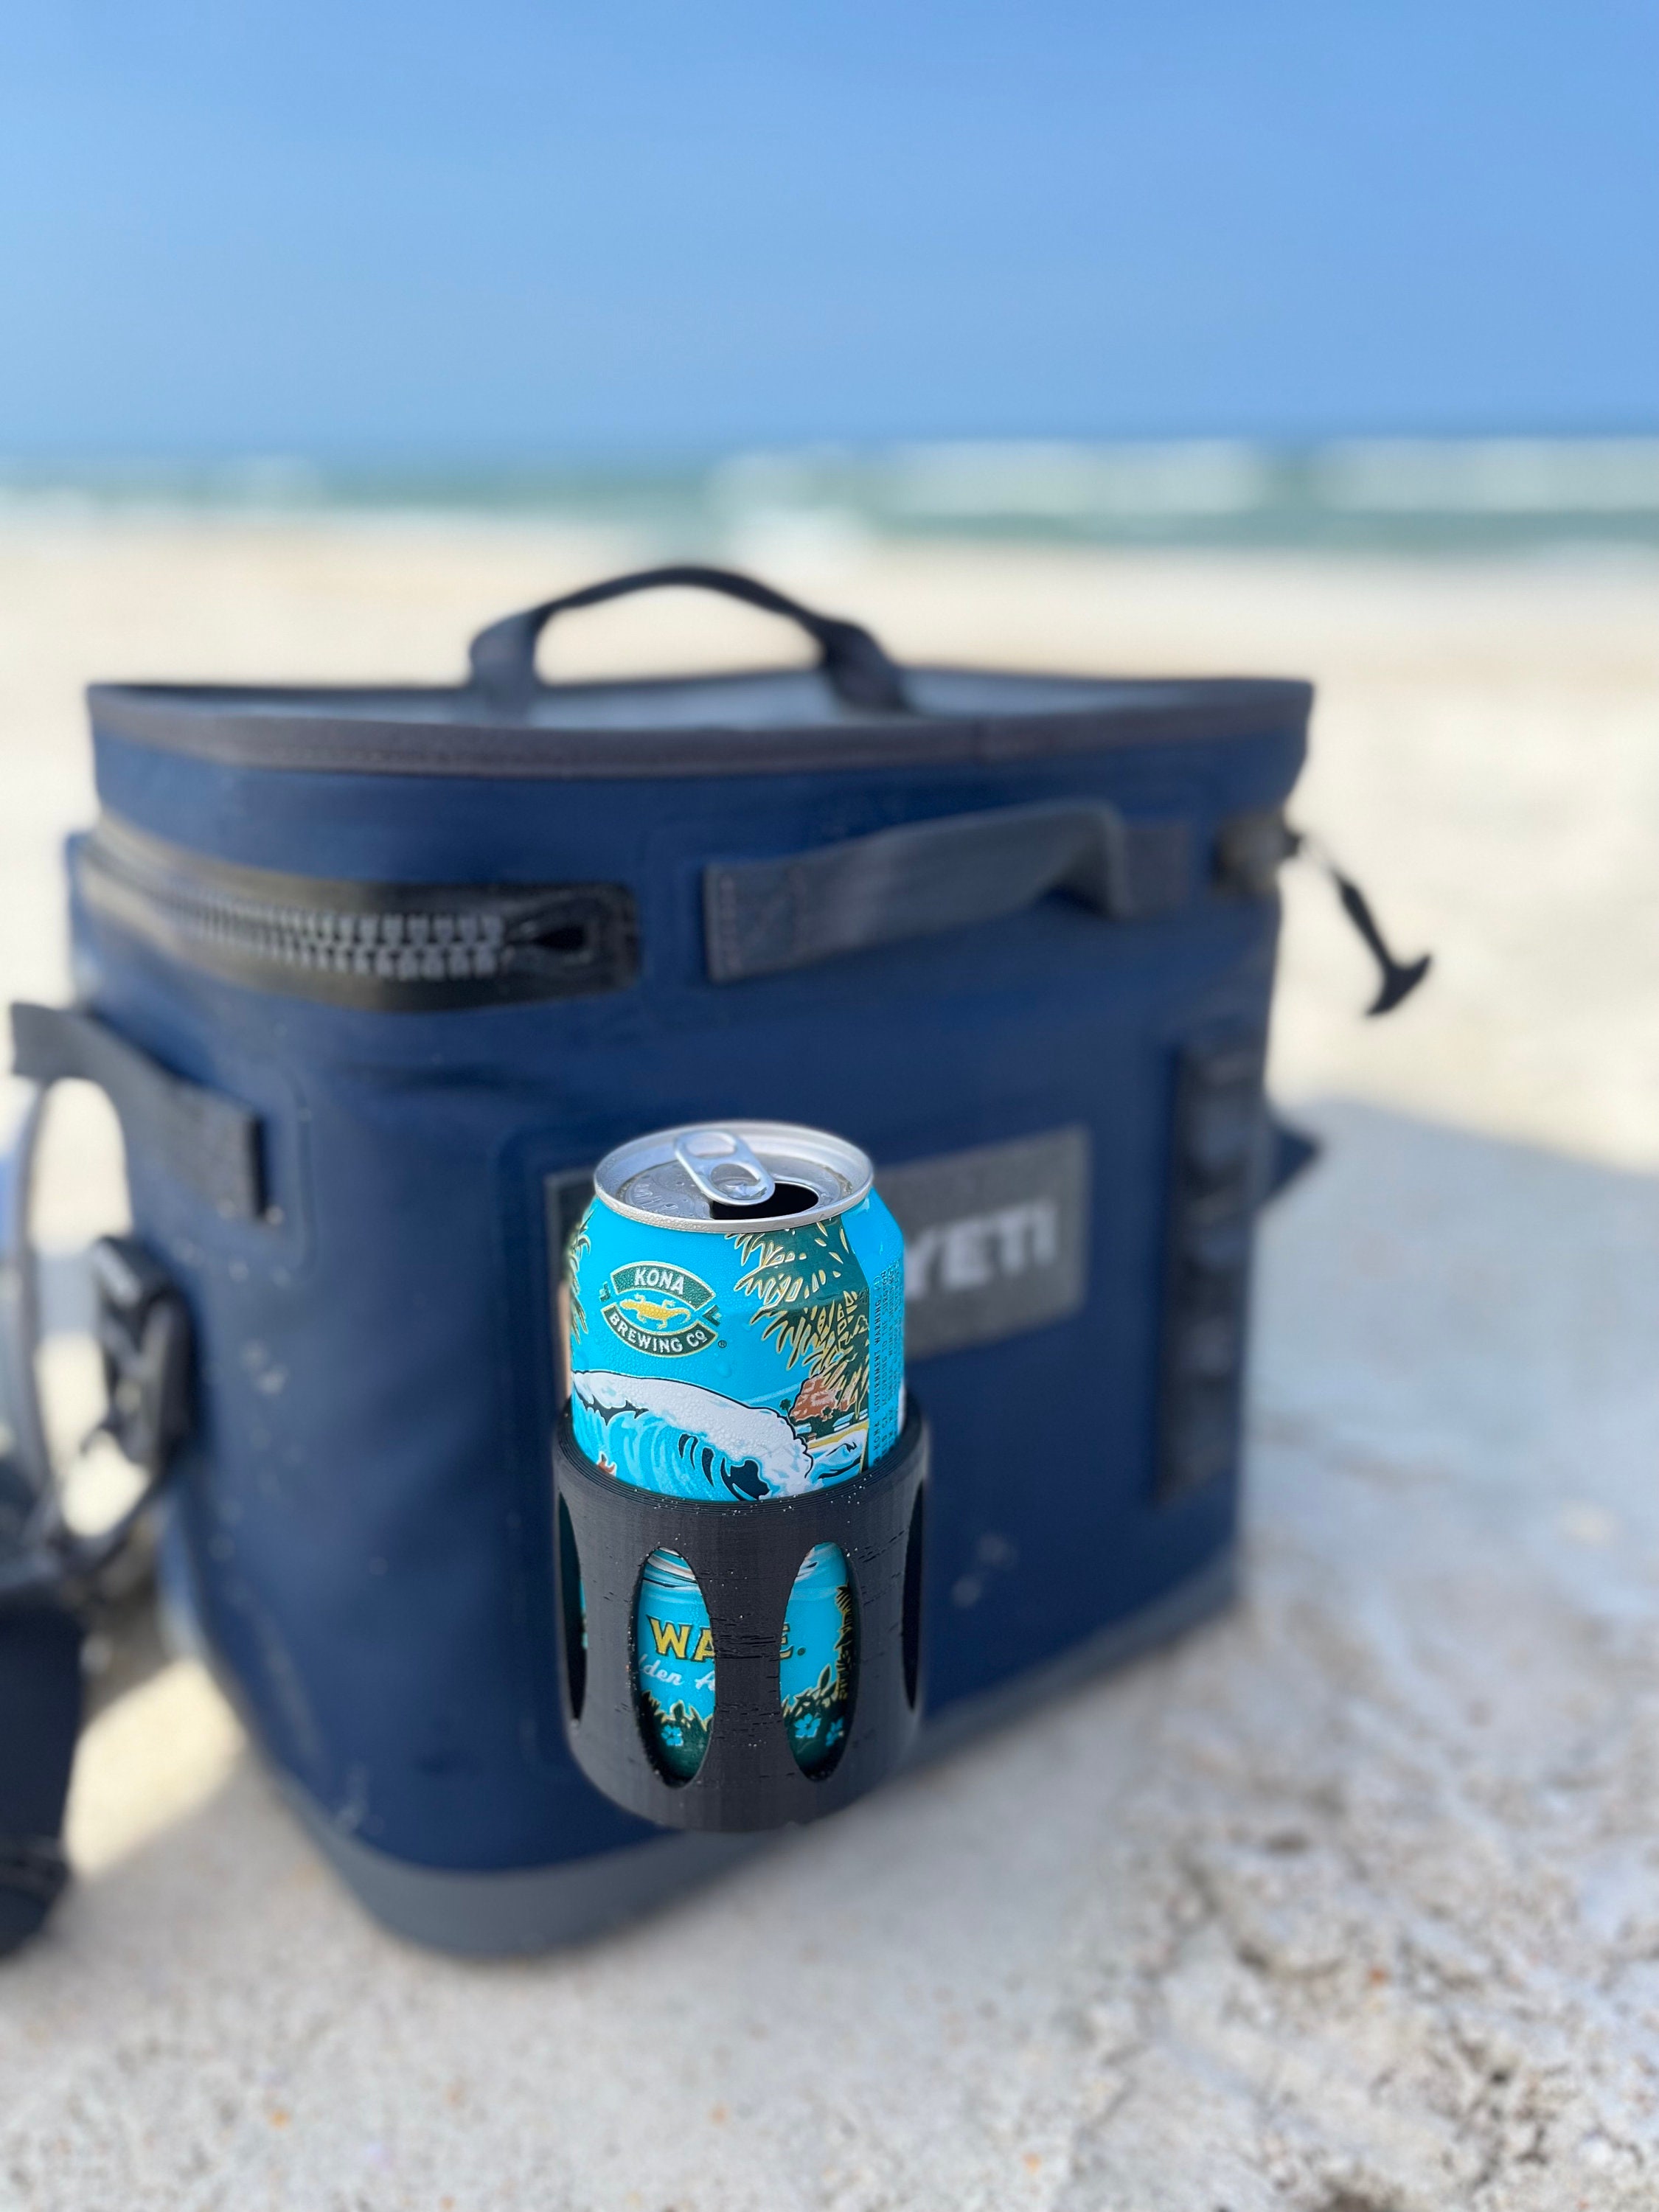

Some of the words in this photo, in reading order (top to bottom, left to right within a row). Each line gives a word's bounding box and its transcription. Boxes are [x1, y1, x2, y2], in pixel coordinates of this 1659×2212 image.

[904, 1202, 1057, 1300] YETI
[633, 1267, 684, 1295] KONA
[609, 1312, 683, 1353] BREWING
